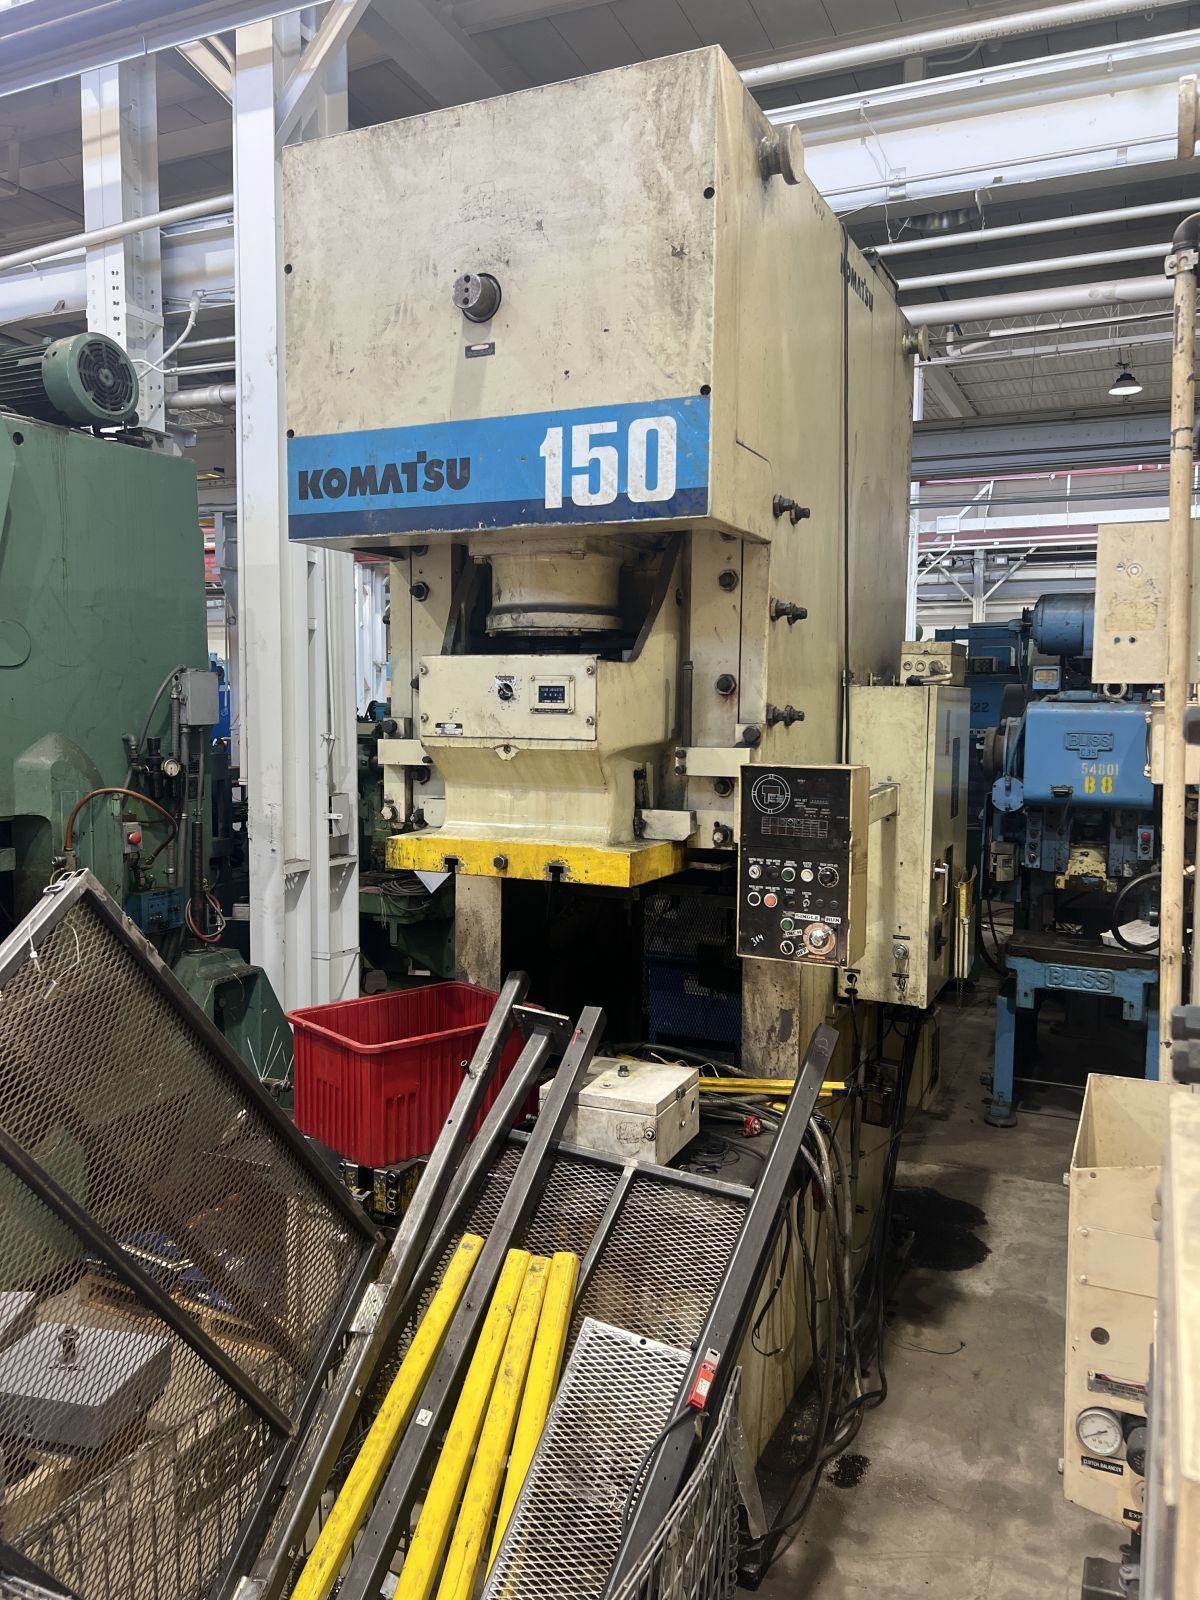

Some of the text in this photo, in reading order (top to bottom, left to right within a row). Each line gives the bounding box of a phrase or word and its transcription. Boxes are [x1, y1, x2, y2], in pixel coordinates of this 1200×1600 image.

[298, 415, 678, 510] KOMATSU 150
[1069, 734, 1111, 748] BLISS
[795, 913, 820, 922] SINGLE
[825, 916, 841, 924] RUN
[1049, 966, 1110, 991] BLISS
